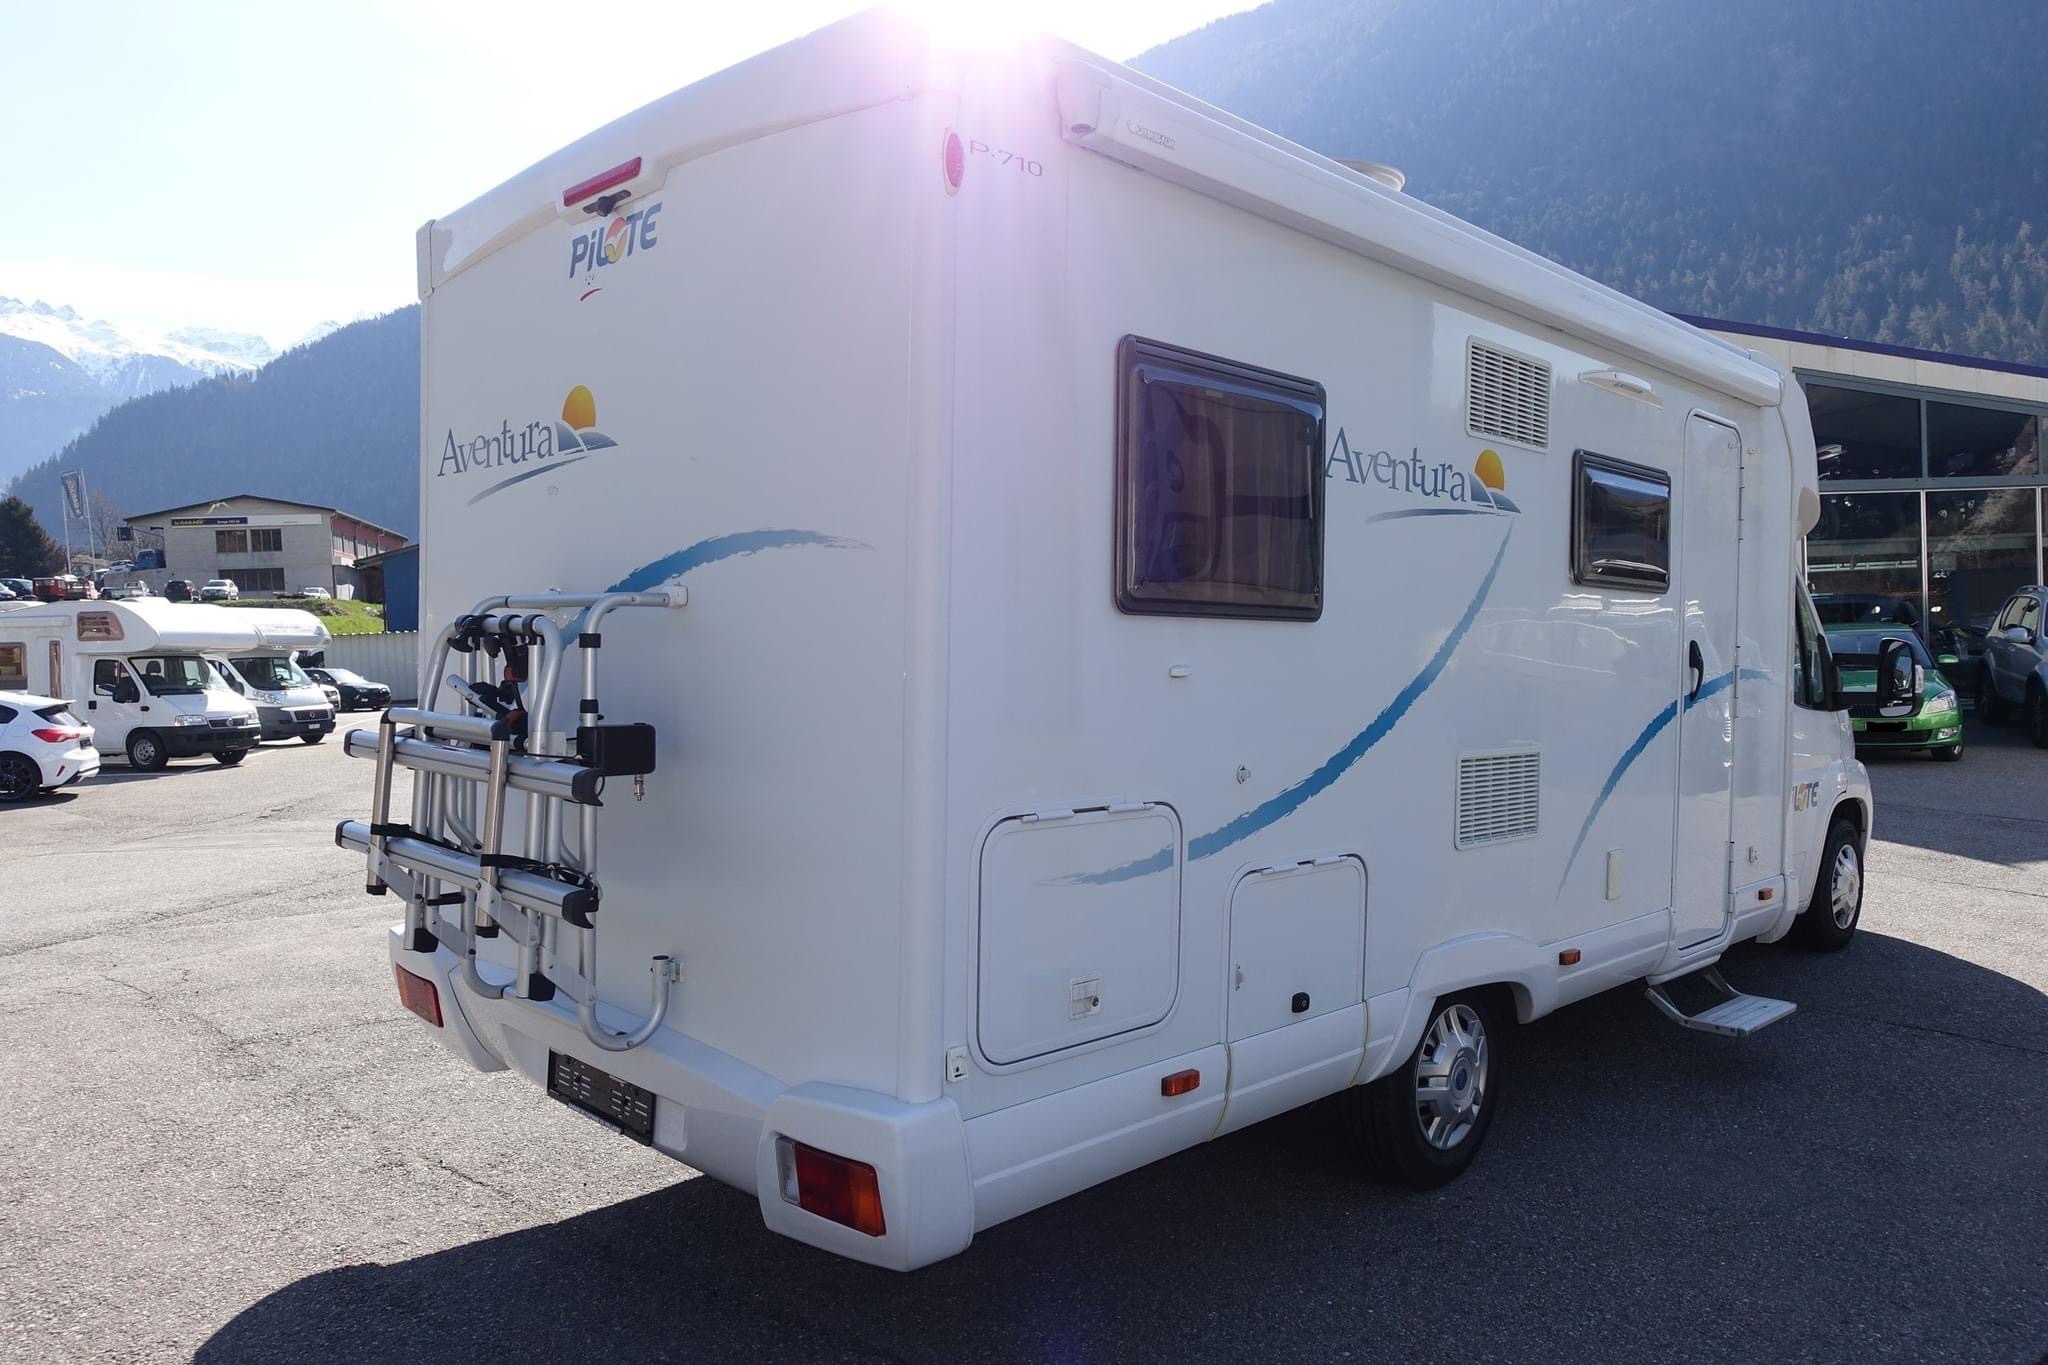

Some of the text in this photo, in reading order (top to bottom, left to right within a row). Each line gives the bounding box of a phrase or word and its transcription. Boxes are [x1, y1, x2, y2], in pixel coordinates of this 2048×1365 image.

[437, 417, 555, 478] Aventura
[1324, 426, 1467, 504] Aventura
[1792, 781, 1819, 811] LOTE
